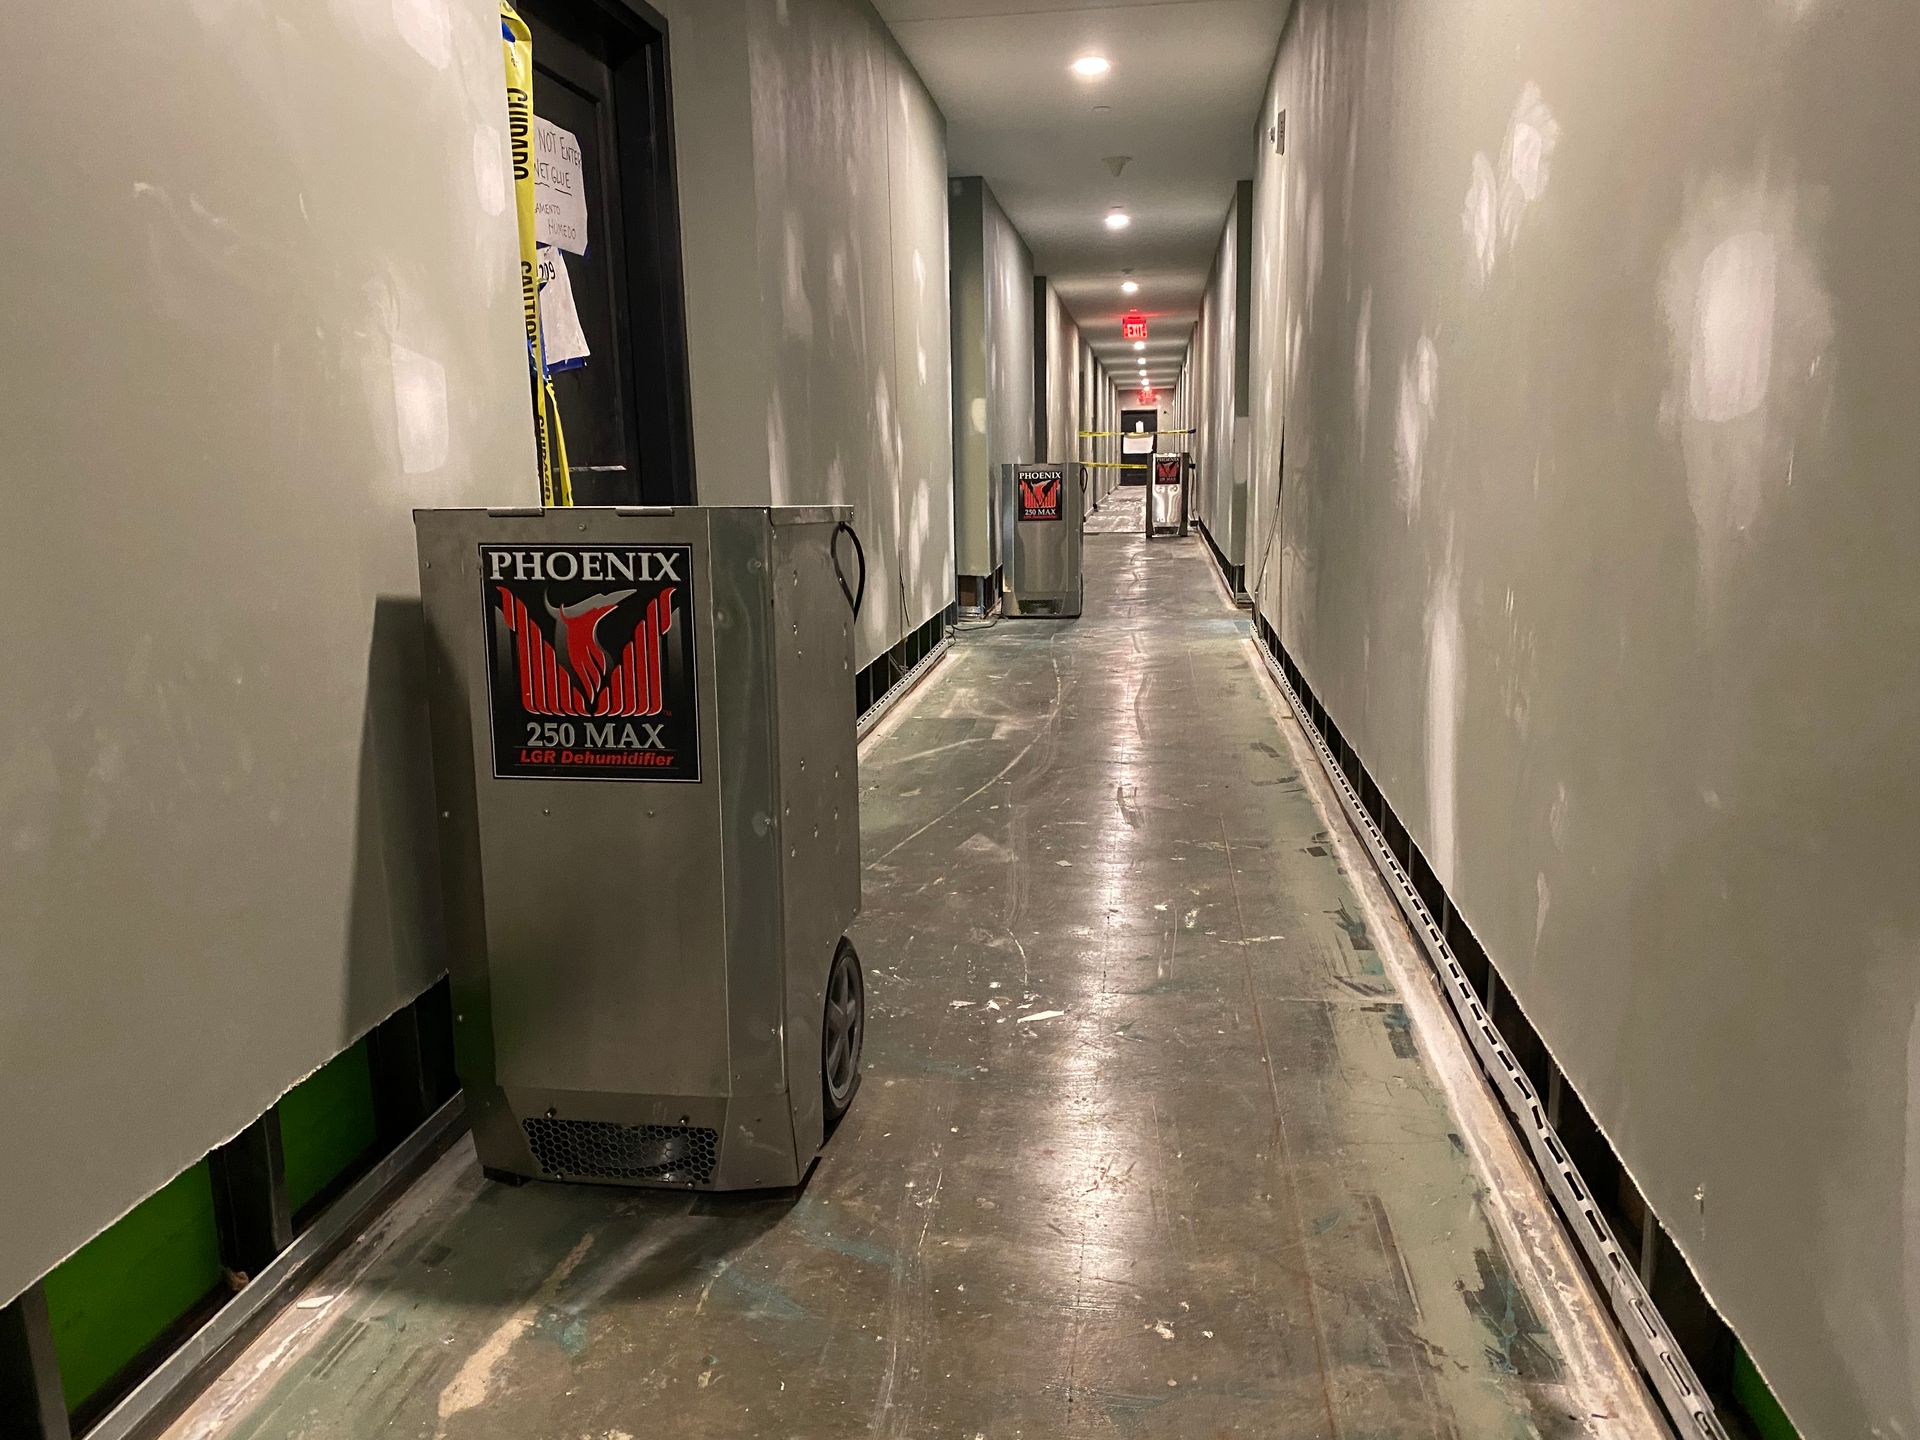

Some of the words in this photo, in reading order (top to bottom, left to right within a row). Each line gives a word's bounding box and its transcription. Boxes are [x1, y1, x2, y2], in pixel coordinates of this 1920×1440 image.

[507, 88, 529, 180] CUIDADO
[538, 128, 556, 154] NOT
[551, 166, 571, 189] GLUE
[548, 218, 577, 240] HUMEDO
[521, 261, 537, 348] CAUTION
[1127, 323, 1143, 338] EXIT
[1019, 472, 1061, 480] PHOENIX
[489, 551, 681, 582] PHOENIX
[526, 722, 575, 747] 250
[583, 722, 666, 749] MAX
[520, 750, 556, 764] LGR
[561, 750, 674, 767] Dehumidifier
